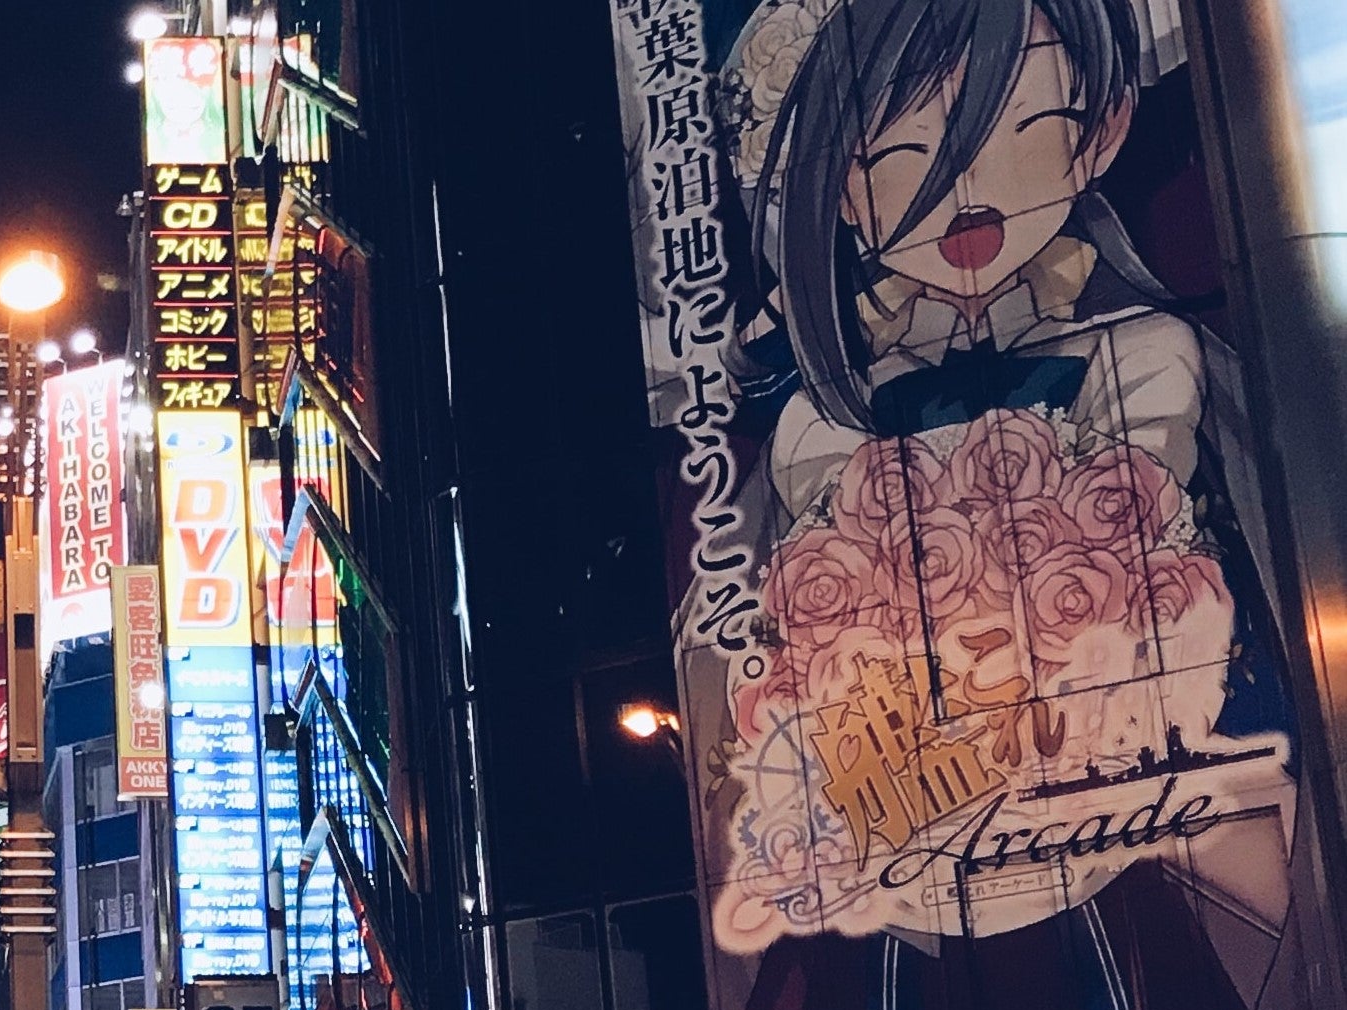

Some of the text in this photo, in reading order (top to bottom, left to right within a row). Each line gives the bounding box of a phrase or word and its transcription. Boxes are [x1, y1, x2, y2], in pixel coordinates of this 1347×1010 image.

[156, 166, 223, 194] ゲーム
[163, 202, 217, 229] CD
[157, 236, 227, 264] アイドル
[157, 273, 230, 299] アニメ
[160, 309, 229, 335] コミック
[165, 344, 228, 371] ホビー
[162, 381, 232, 408] フィギュア
[60, 397, 81, 588] AKIHABARA
[173, 478, 241, 622] DVD
[131, 775, 167, 788] ONE
[879, 775, 1221, 888] Arcade
